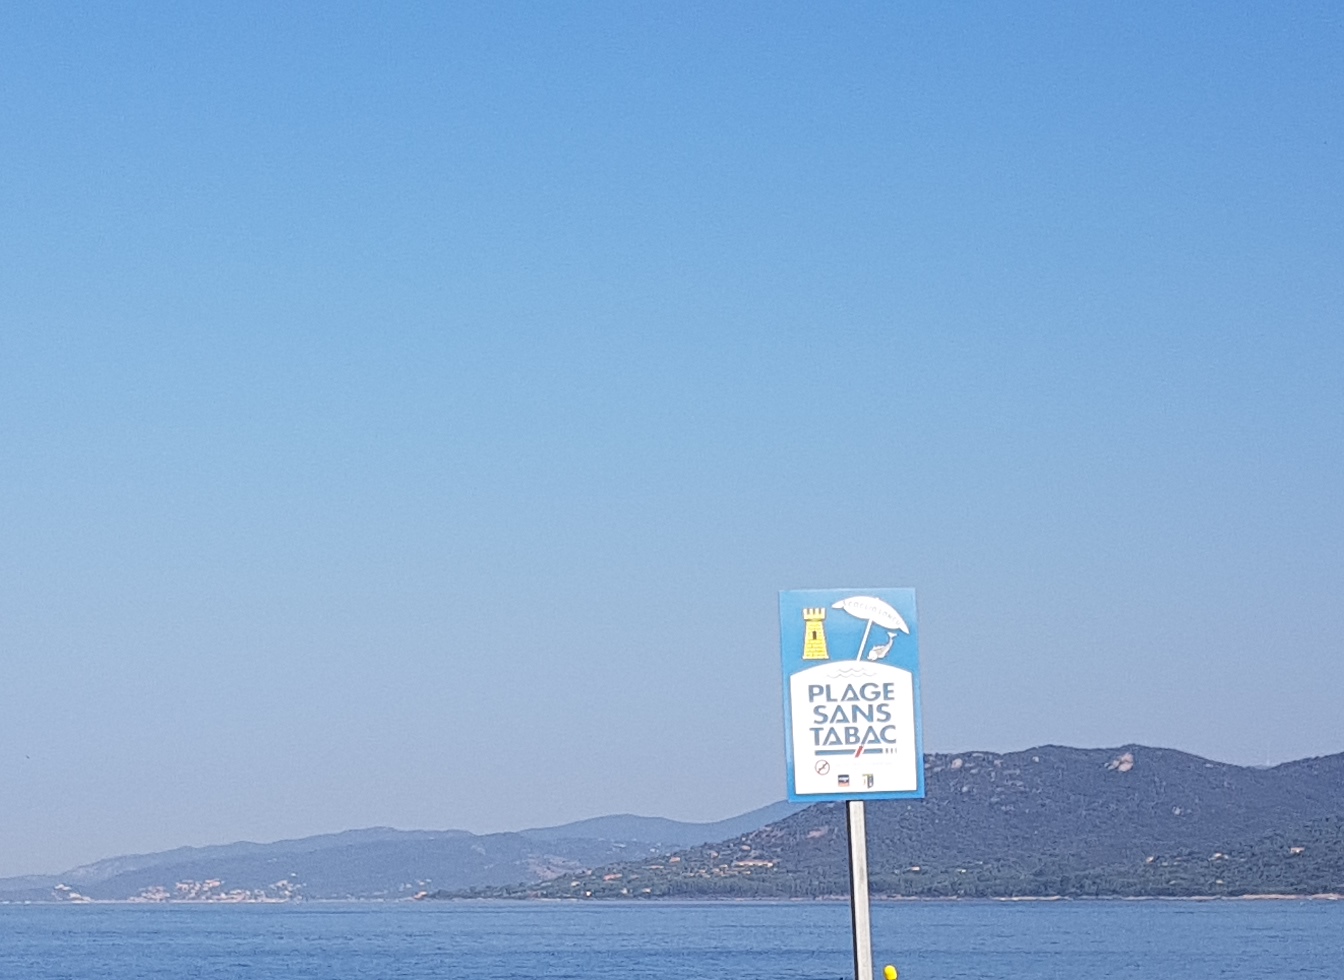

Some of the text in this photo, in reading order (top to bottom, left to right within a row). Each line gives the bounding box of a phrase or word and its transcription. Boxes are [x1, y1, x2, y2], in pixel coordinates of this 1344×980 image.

[808, 682, 895, 703] PLAGE
[813, 703, 892, 724] SANS
[809, 724, 897, 746] TABAC
